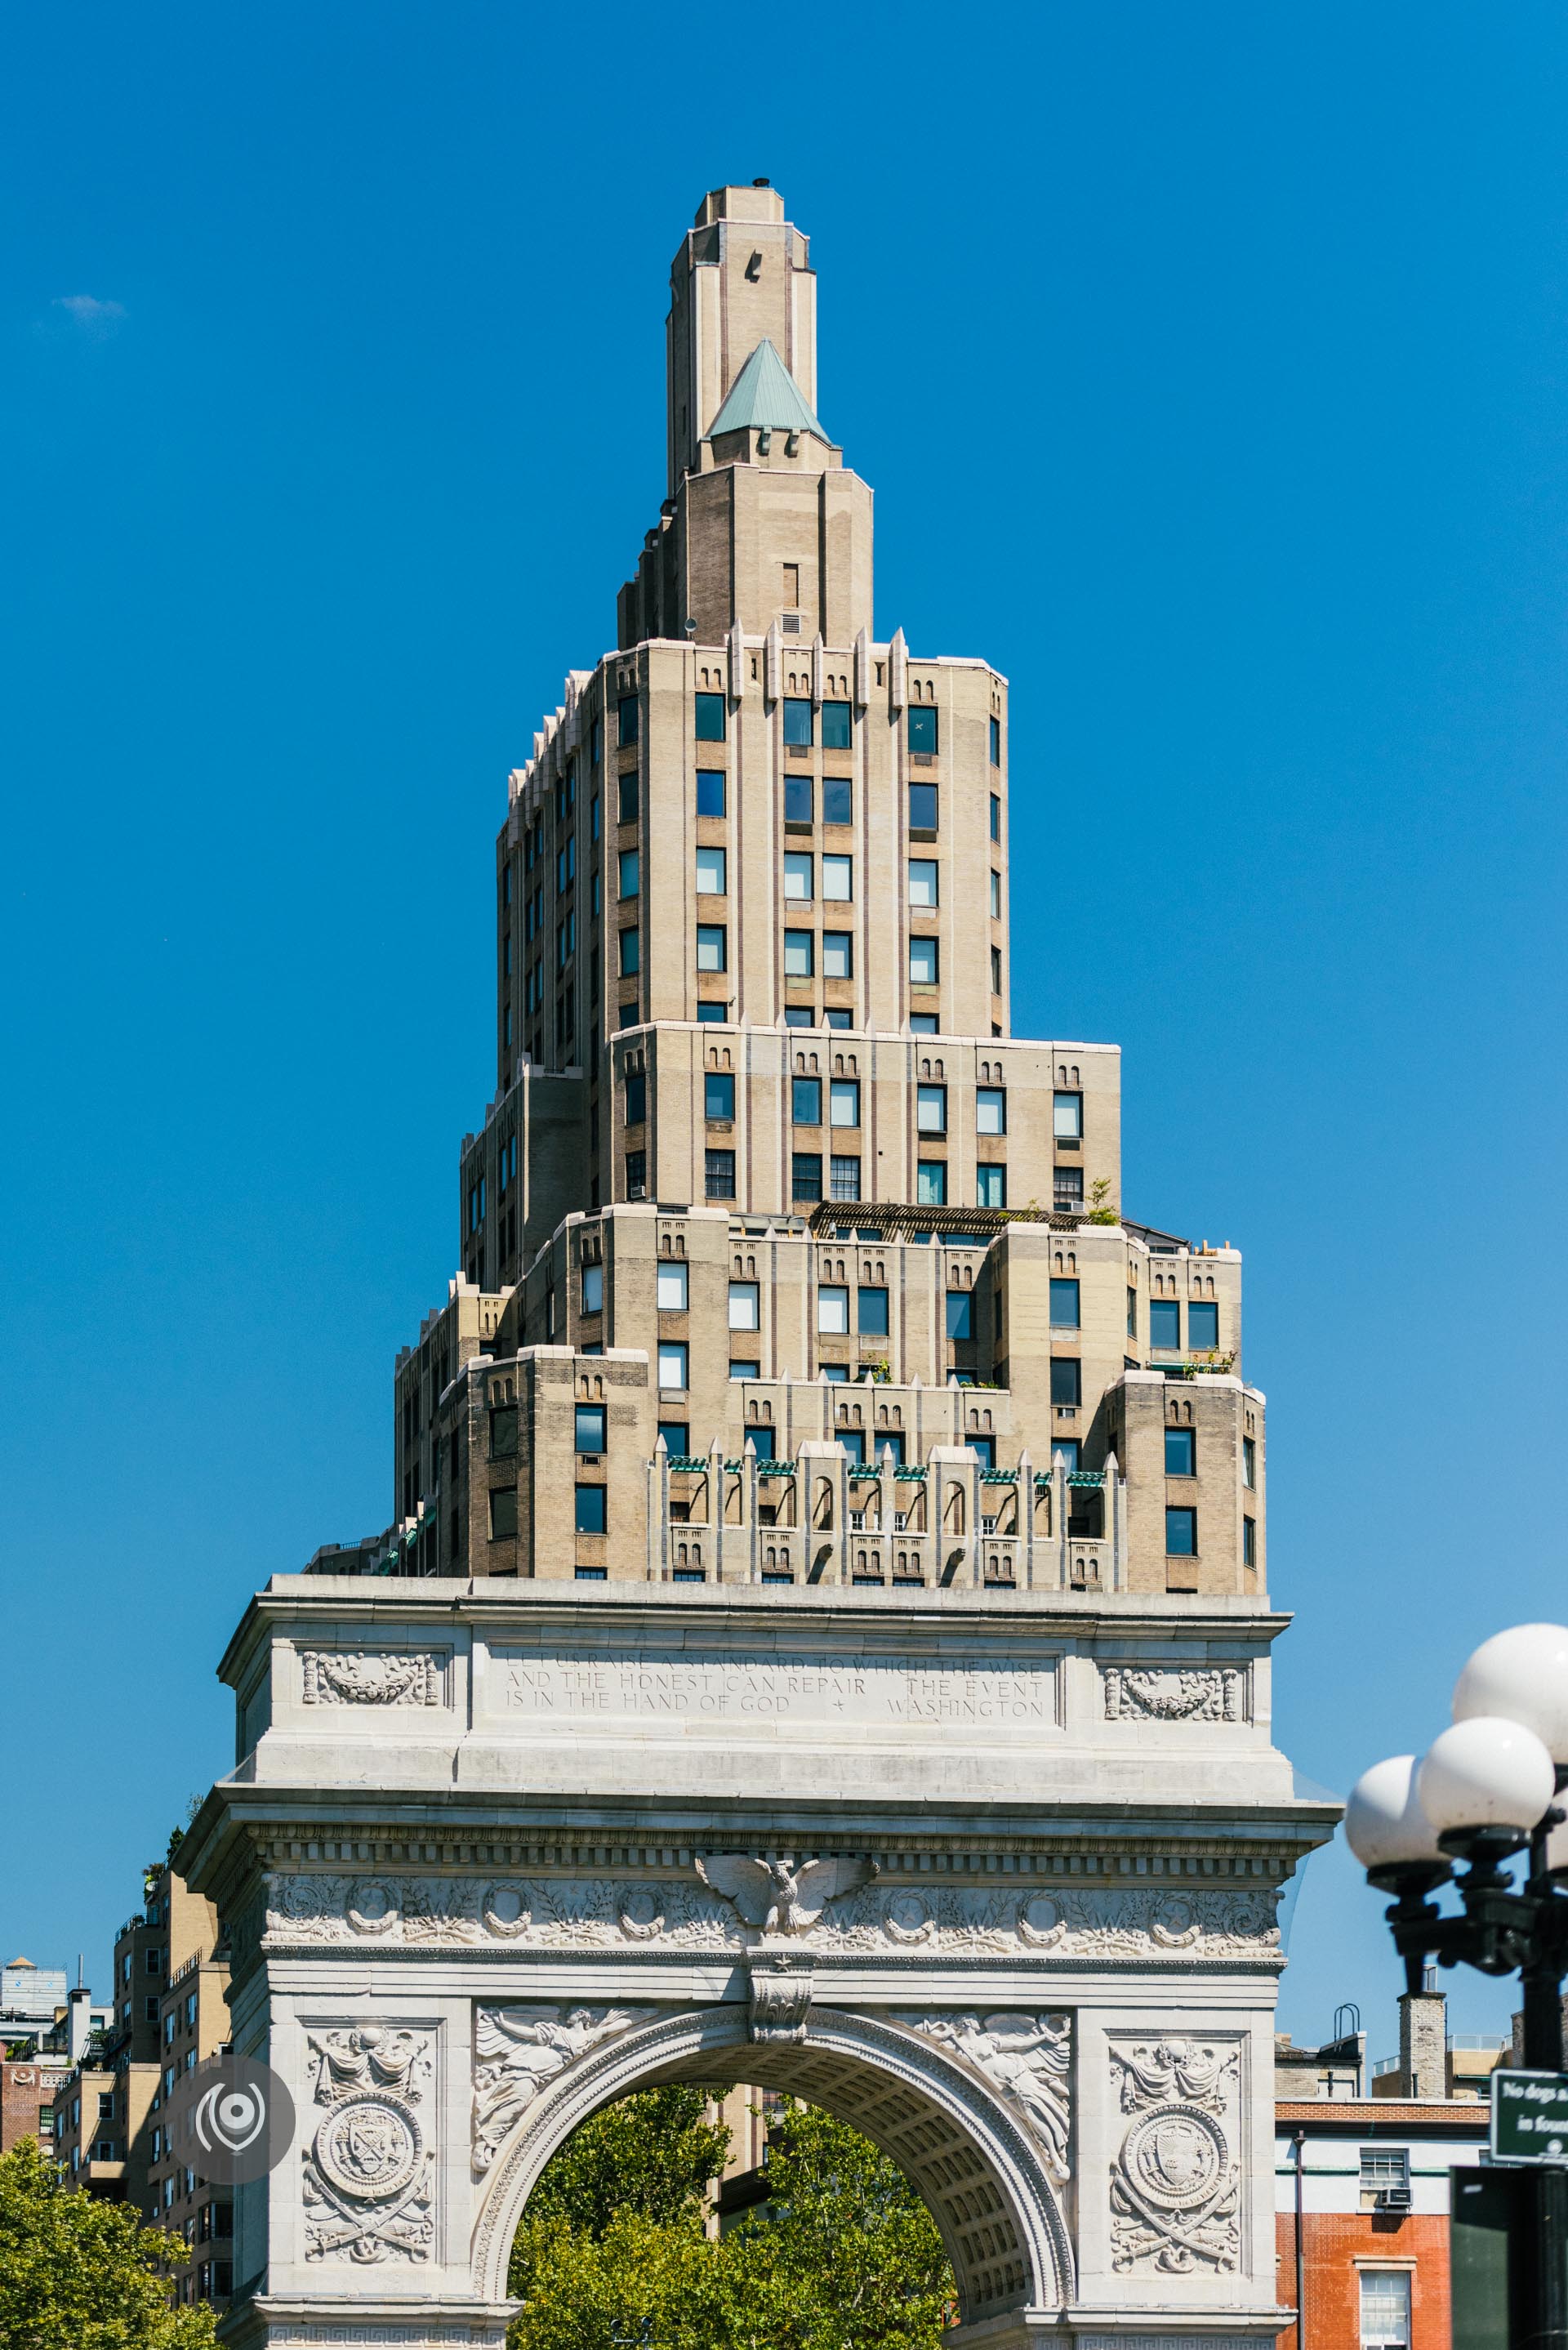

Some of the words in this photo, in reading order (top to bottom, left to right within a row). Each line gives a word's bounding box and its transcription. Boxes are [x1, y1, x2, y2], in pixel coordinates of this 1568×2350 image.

[506, 1652, 549, 1668] LET
[555, 1652, 580, 1668] US
[588, 1653, 652, 1670] RAISE
[661, 1655, 675, 1670] A
[684, 1655, 805, 1673] STANDARD
[813, 1658, 844, 1674] TO
[853, 1659, 928, 1676] WHICH
[935, 1661, 980, 1677] THE
[988, 1661, 1042, 1679] WISE
[506, 1670, 550, 1688] AND
[560, 1672, 606, 1689] THE
[621, 1674, 713, 1691] HONEST
[726, 1675, 775, 1692] CAN
[788, 1677, 866, 1695] REPAIR
[905, 1678, 951, 1696] THE
[965, 1679, 1043, 1698] EVENT
[506, 1691, 523, 1707] IS
[534, 1691, 554, 1707] IN
[564, 1692, 610, 1709] THE
[624, 1692, 688, 1710] HAND
[700, 1695, 731, 1712] OF
[741, 1696, 790, 1713] GOD
[887, 1699, 1044, 1717] WASHINGTON
[1503, 2082, 1524, 2098] No
[1525, 2083, 1557, 2104] dogs
